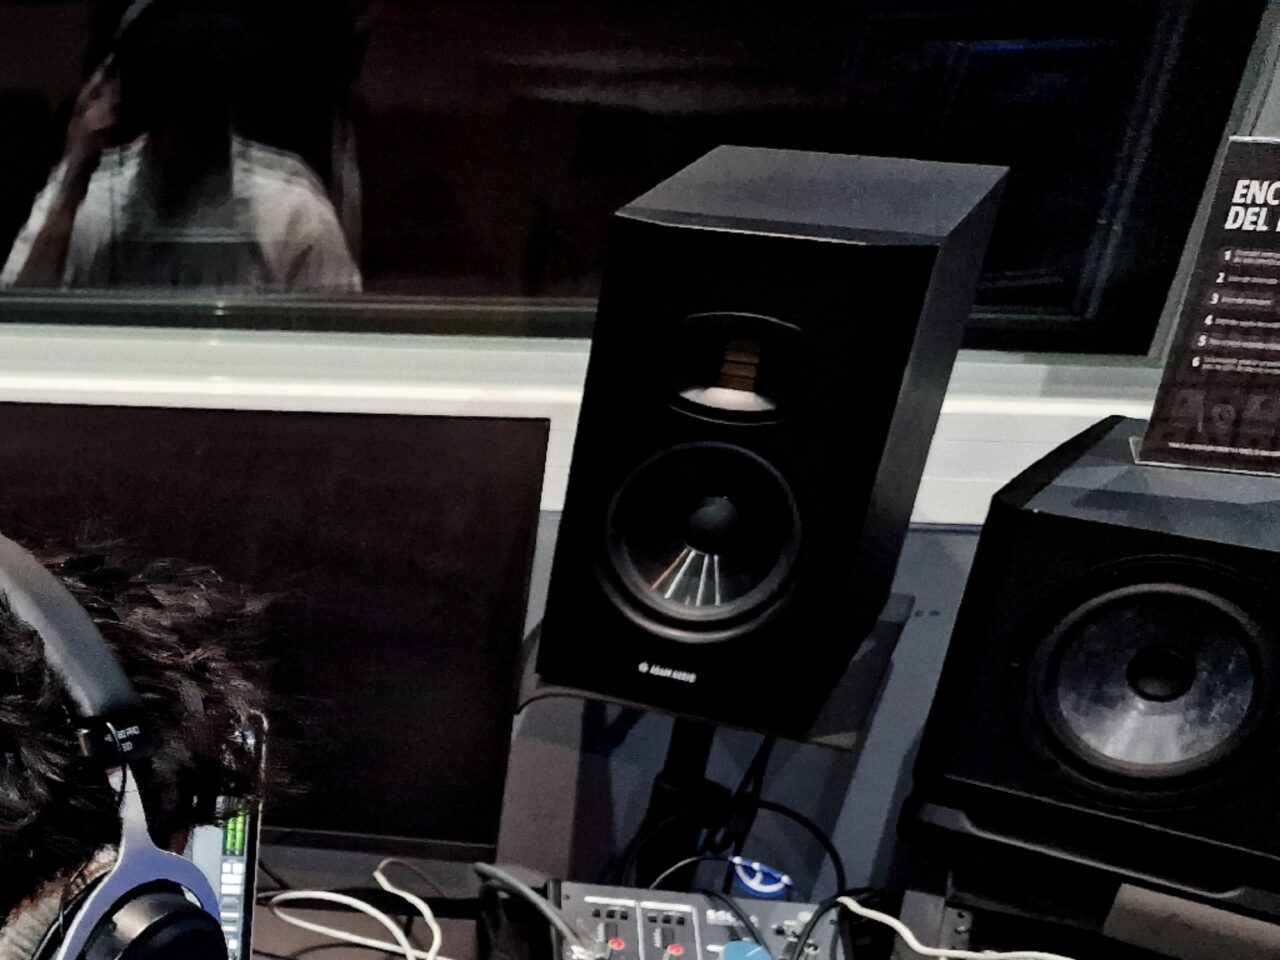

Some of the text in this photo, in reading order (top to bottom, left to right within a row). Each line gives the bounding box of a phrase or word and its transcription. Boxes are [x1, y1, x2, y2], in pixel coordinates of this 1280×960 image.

[1224, 206, 1269, 231] DEL
[1224, 250, 1232, 261] 1
[1216, 272, 1225, 283] 2
[1210, 292, 1219, 304] 3
